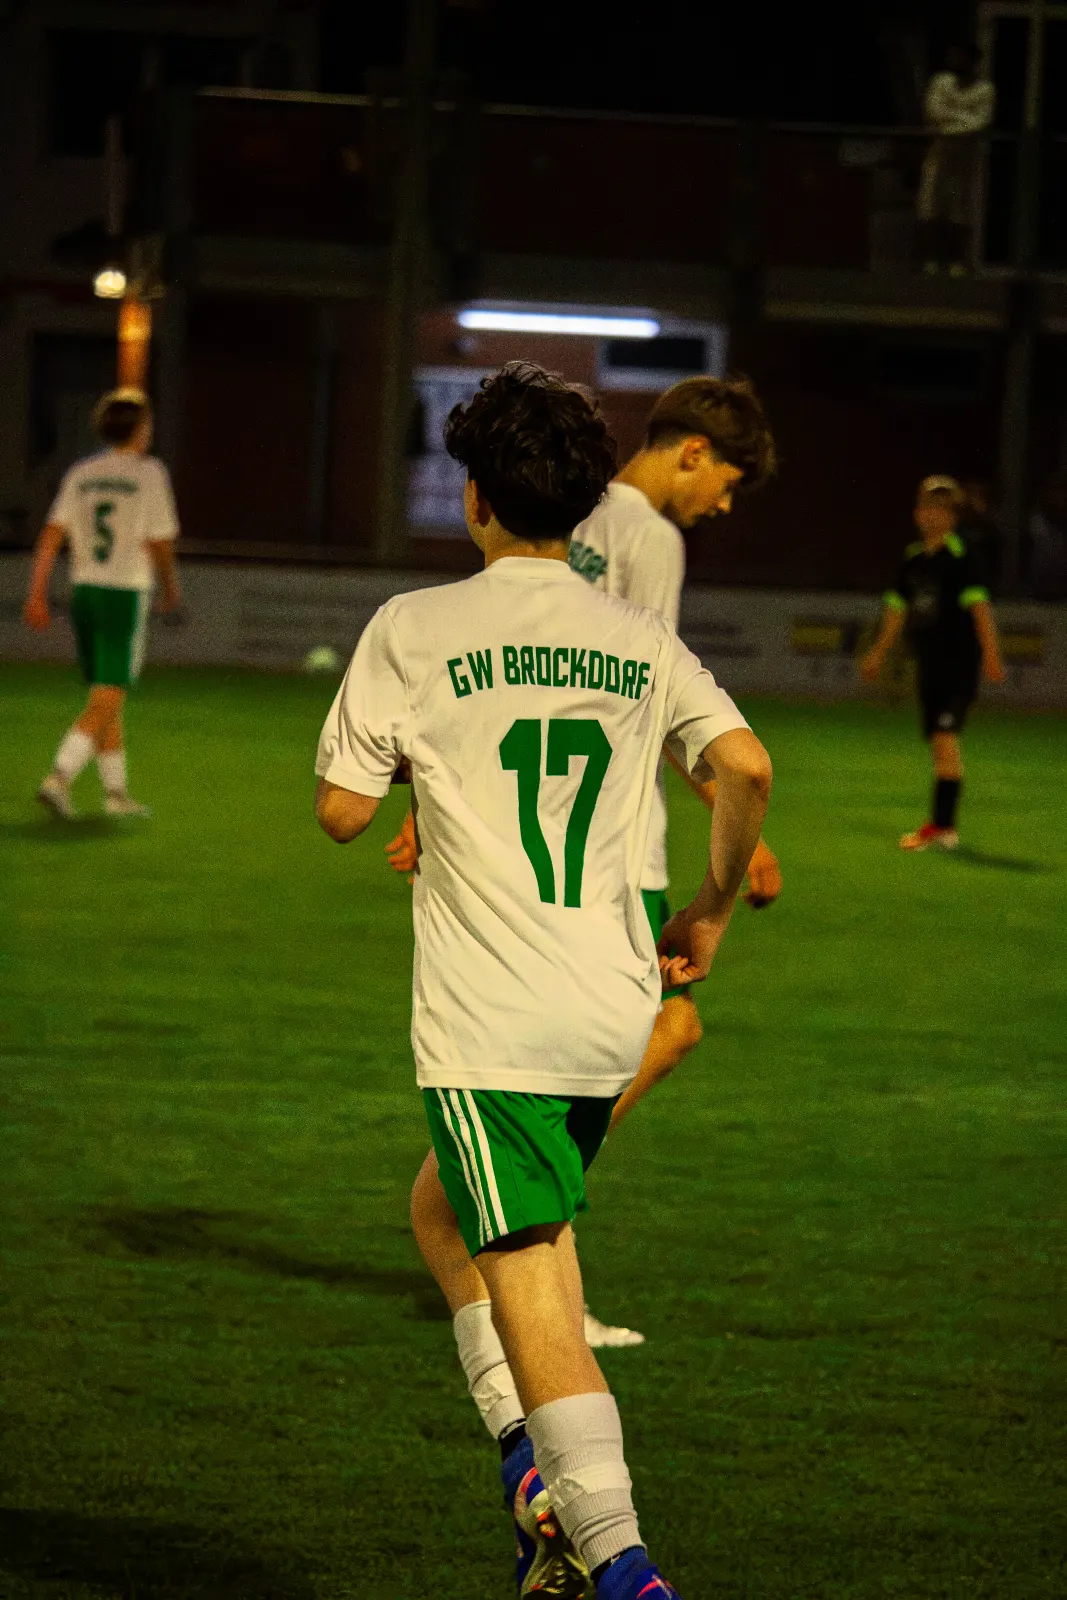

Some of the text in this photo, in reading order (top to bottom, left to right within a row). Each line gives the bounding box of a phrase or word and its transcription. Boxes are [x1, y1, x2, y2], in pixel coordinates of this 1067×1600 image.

[94, 501, 115, 563] 5
[447, 646, 650, 700] GW BROCKDORF
[499, 719, 612, 908] 17
